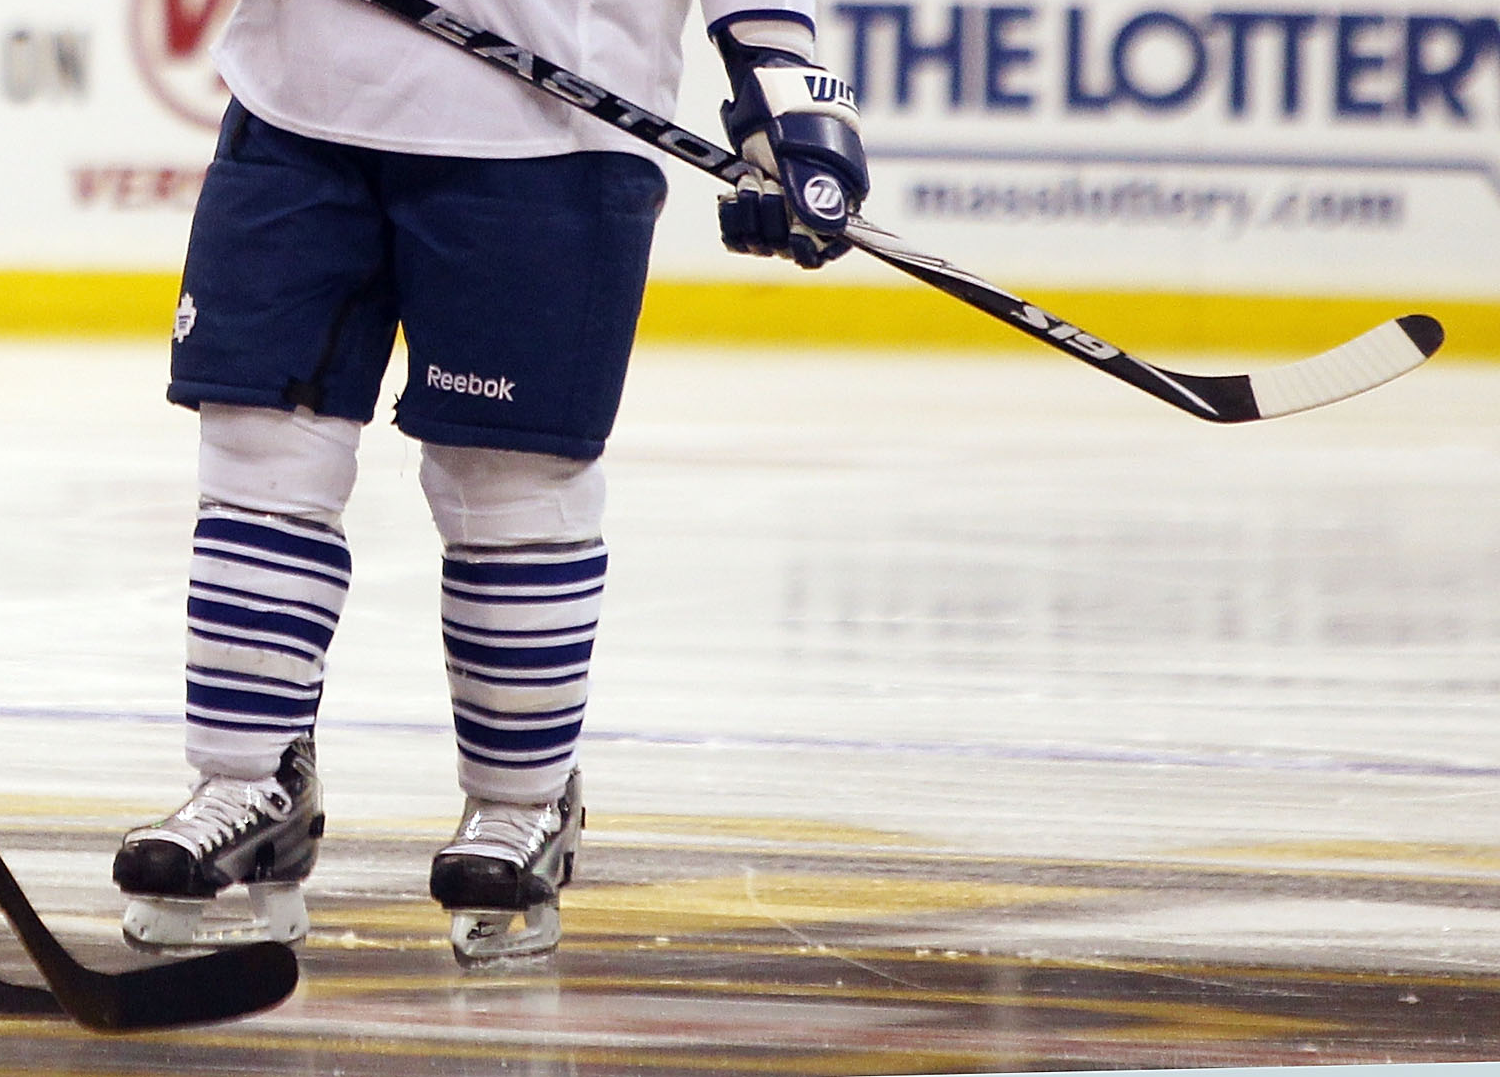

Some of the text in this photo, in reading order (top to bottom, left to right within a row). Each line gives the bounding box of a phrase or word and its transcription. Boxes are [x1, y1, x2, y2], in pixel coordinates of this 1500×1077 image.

[834, 3, 1035, 108] THE
[1010, 303, 1121, 361] S19
[427, 363, 516, 402] Reebok
